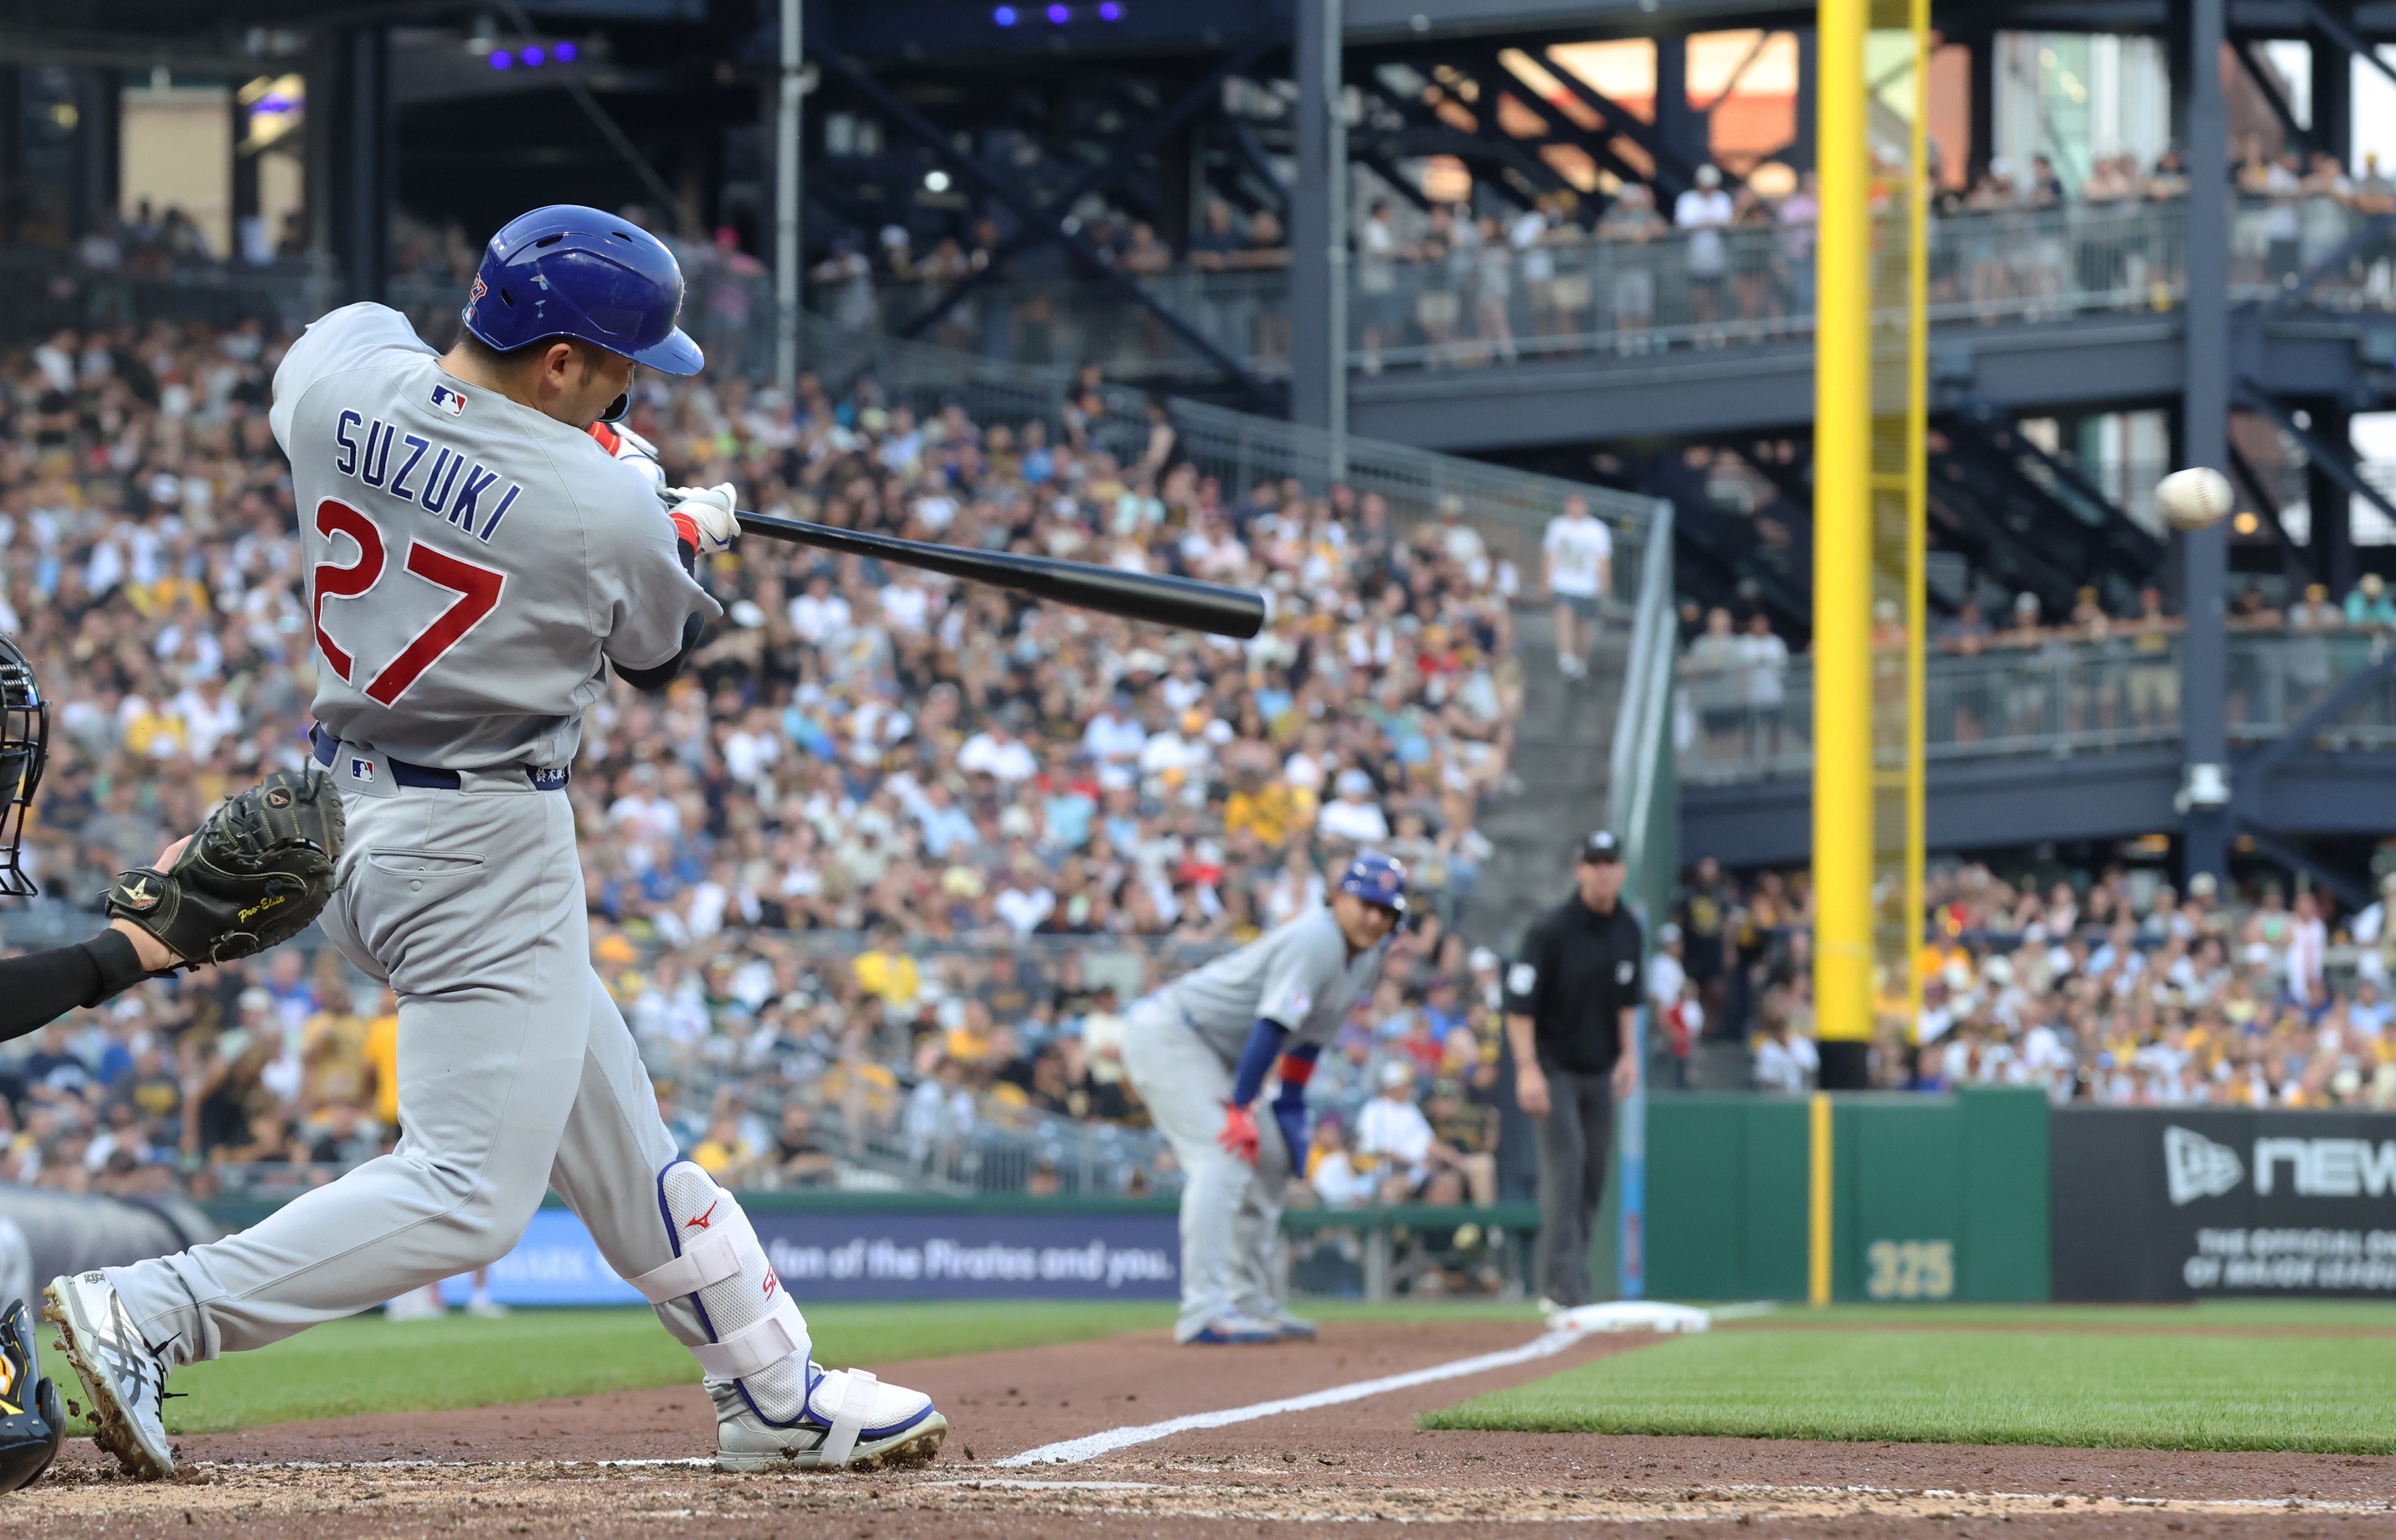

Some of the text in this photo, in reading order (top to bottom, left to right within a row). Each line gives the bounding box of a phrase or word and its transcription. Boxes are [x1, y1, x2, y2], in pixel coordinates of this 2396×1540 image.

[336, 408, 523, 545] SUZUKI
[313, 495, 507, 710] 27
[238, 895, 285, 924] Pro-Elite
[769, 1237, 1175, 1287] fan of the Pirates and you.
[2196, 1228, 2247, 1255] THE
[2249, 1228, 2363, 1255] OFFICIAL
[1867, 1240, 1954, 1299] 325
[2183, 1255, 2220, 1288] OF
[2223, 1255, 2315, 1287] MAJOR
